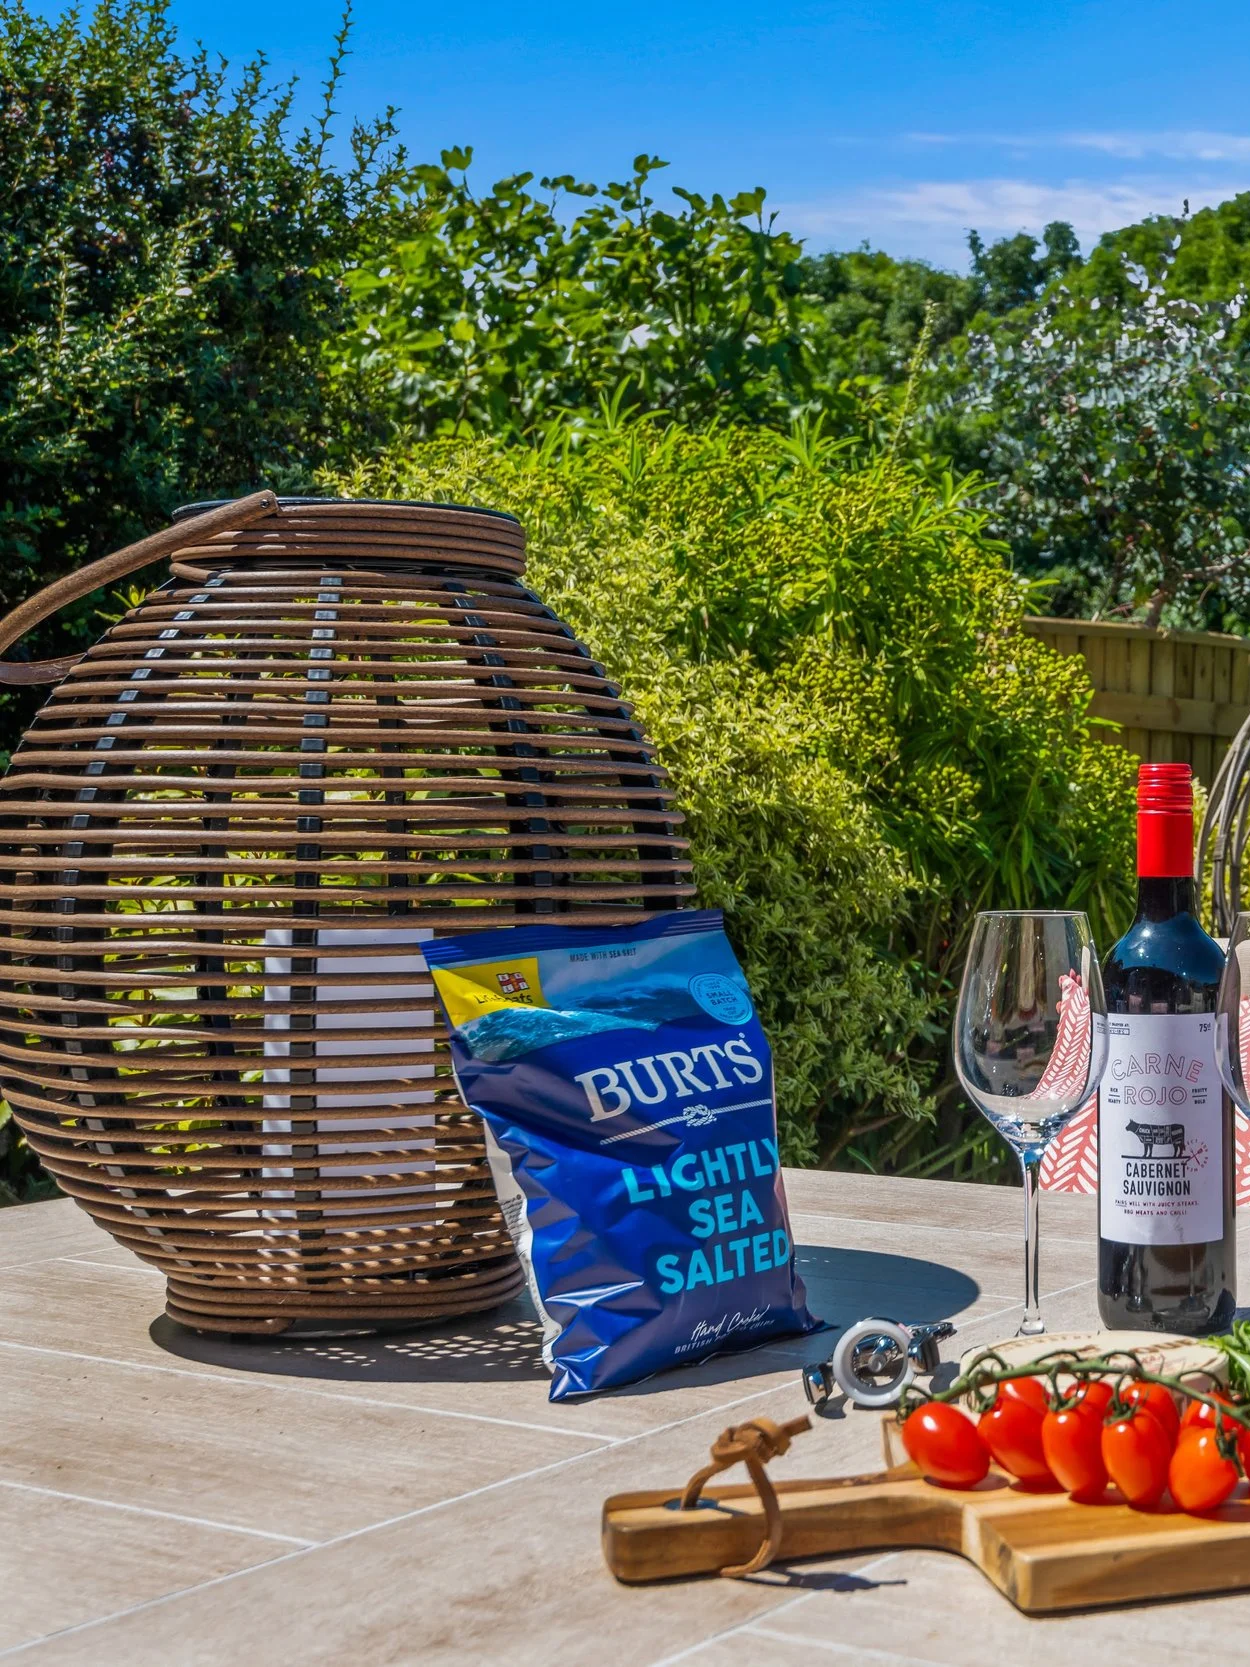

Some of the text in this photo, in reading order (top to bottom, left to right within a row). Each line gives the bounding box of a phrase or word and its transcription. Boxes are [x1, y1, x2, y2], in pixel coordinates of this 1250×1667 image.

[609, 950, 621, 959] SEA
[706, 990, 734, 999] SMALL
[710, 997, 737, 1006] BATCH
[1111, 1052, 1204, 1083] CARNE
[574, 1038, 763, 1123] BURTS
[1123, 1085, 1188, 1106] ROJO
[621, 1136, 780, 1204] LIGHTLY
[1126, 1162, 1187, 1178] CABERNET
[1123, 1179, 1191, 1196] SAUVIGNON
[688, 1189, 764, 1239] SEA
[656, 1228, 790, 1294] SALTED
[690, 1314, 727, 1341] Hand
[674, 1337, 712, 1354] BRITISH
